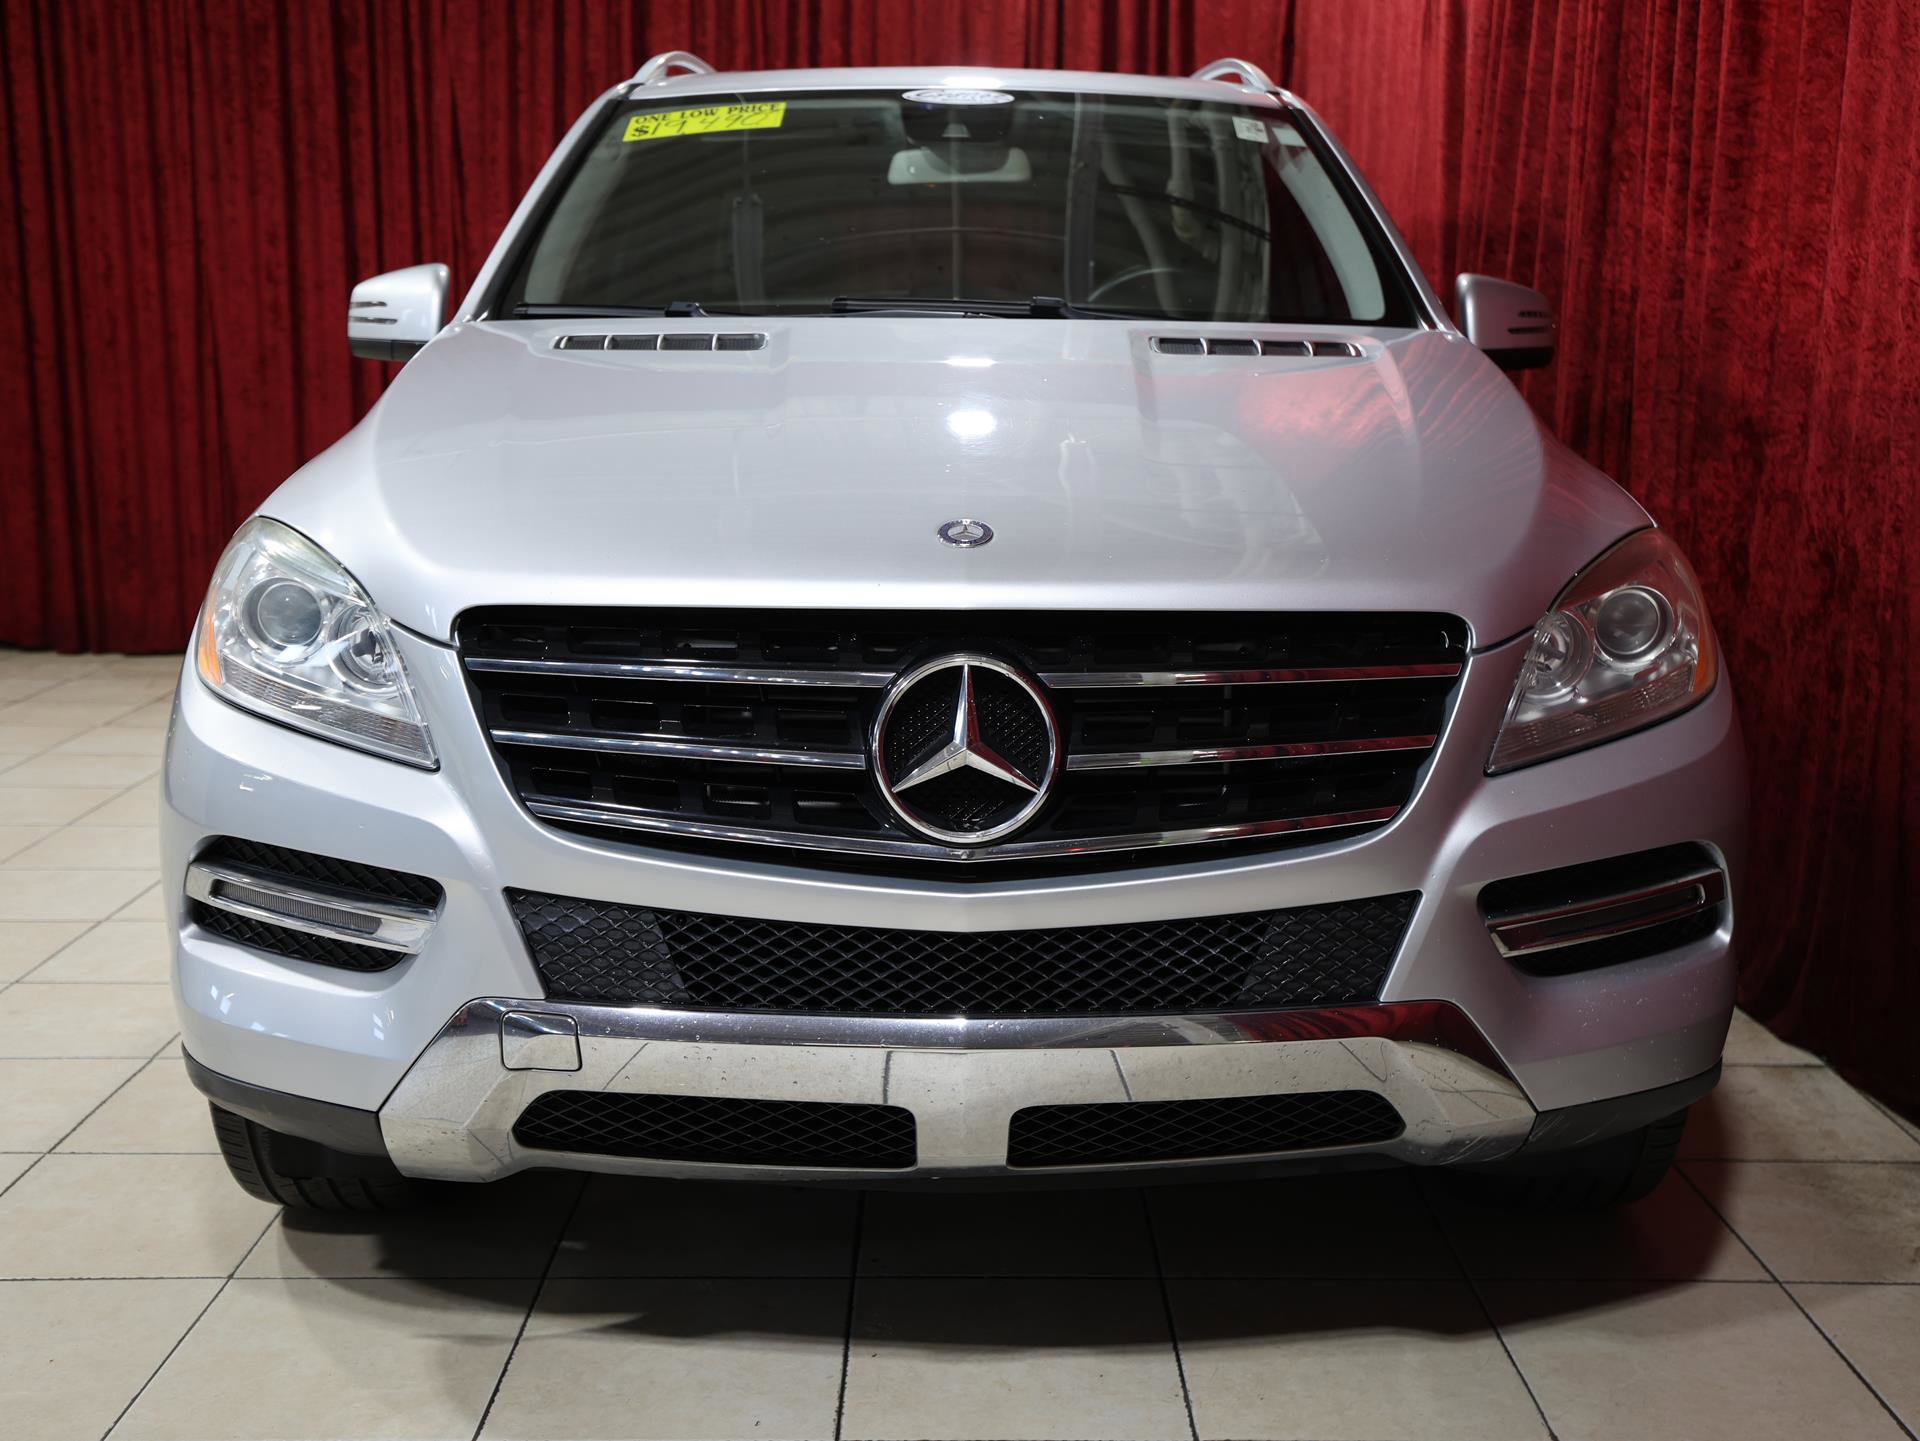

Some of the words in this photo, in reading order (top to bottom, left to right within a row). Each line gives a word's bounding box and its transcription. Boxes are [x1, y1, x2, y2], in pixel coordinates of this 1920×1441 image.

[635, 112, 671, 124] ONE
[680, 107, 719, 119] LOW
[728, 103, 781, 114] PRICE
